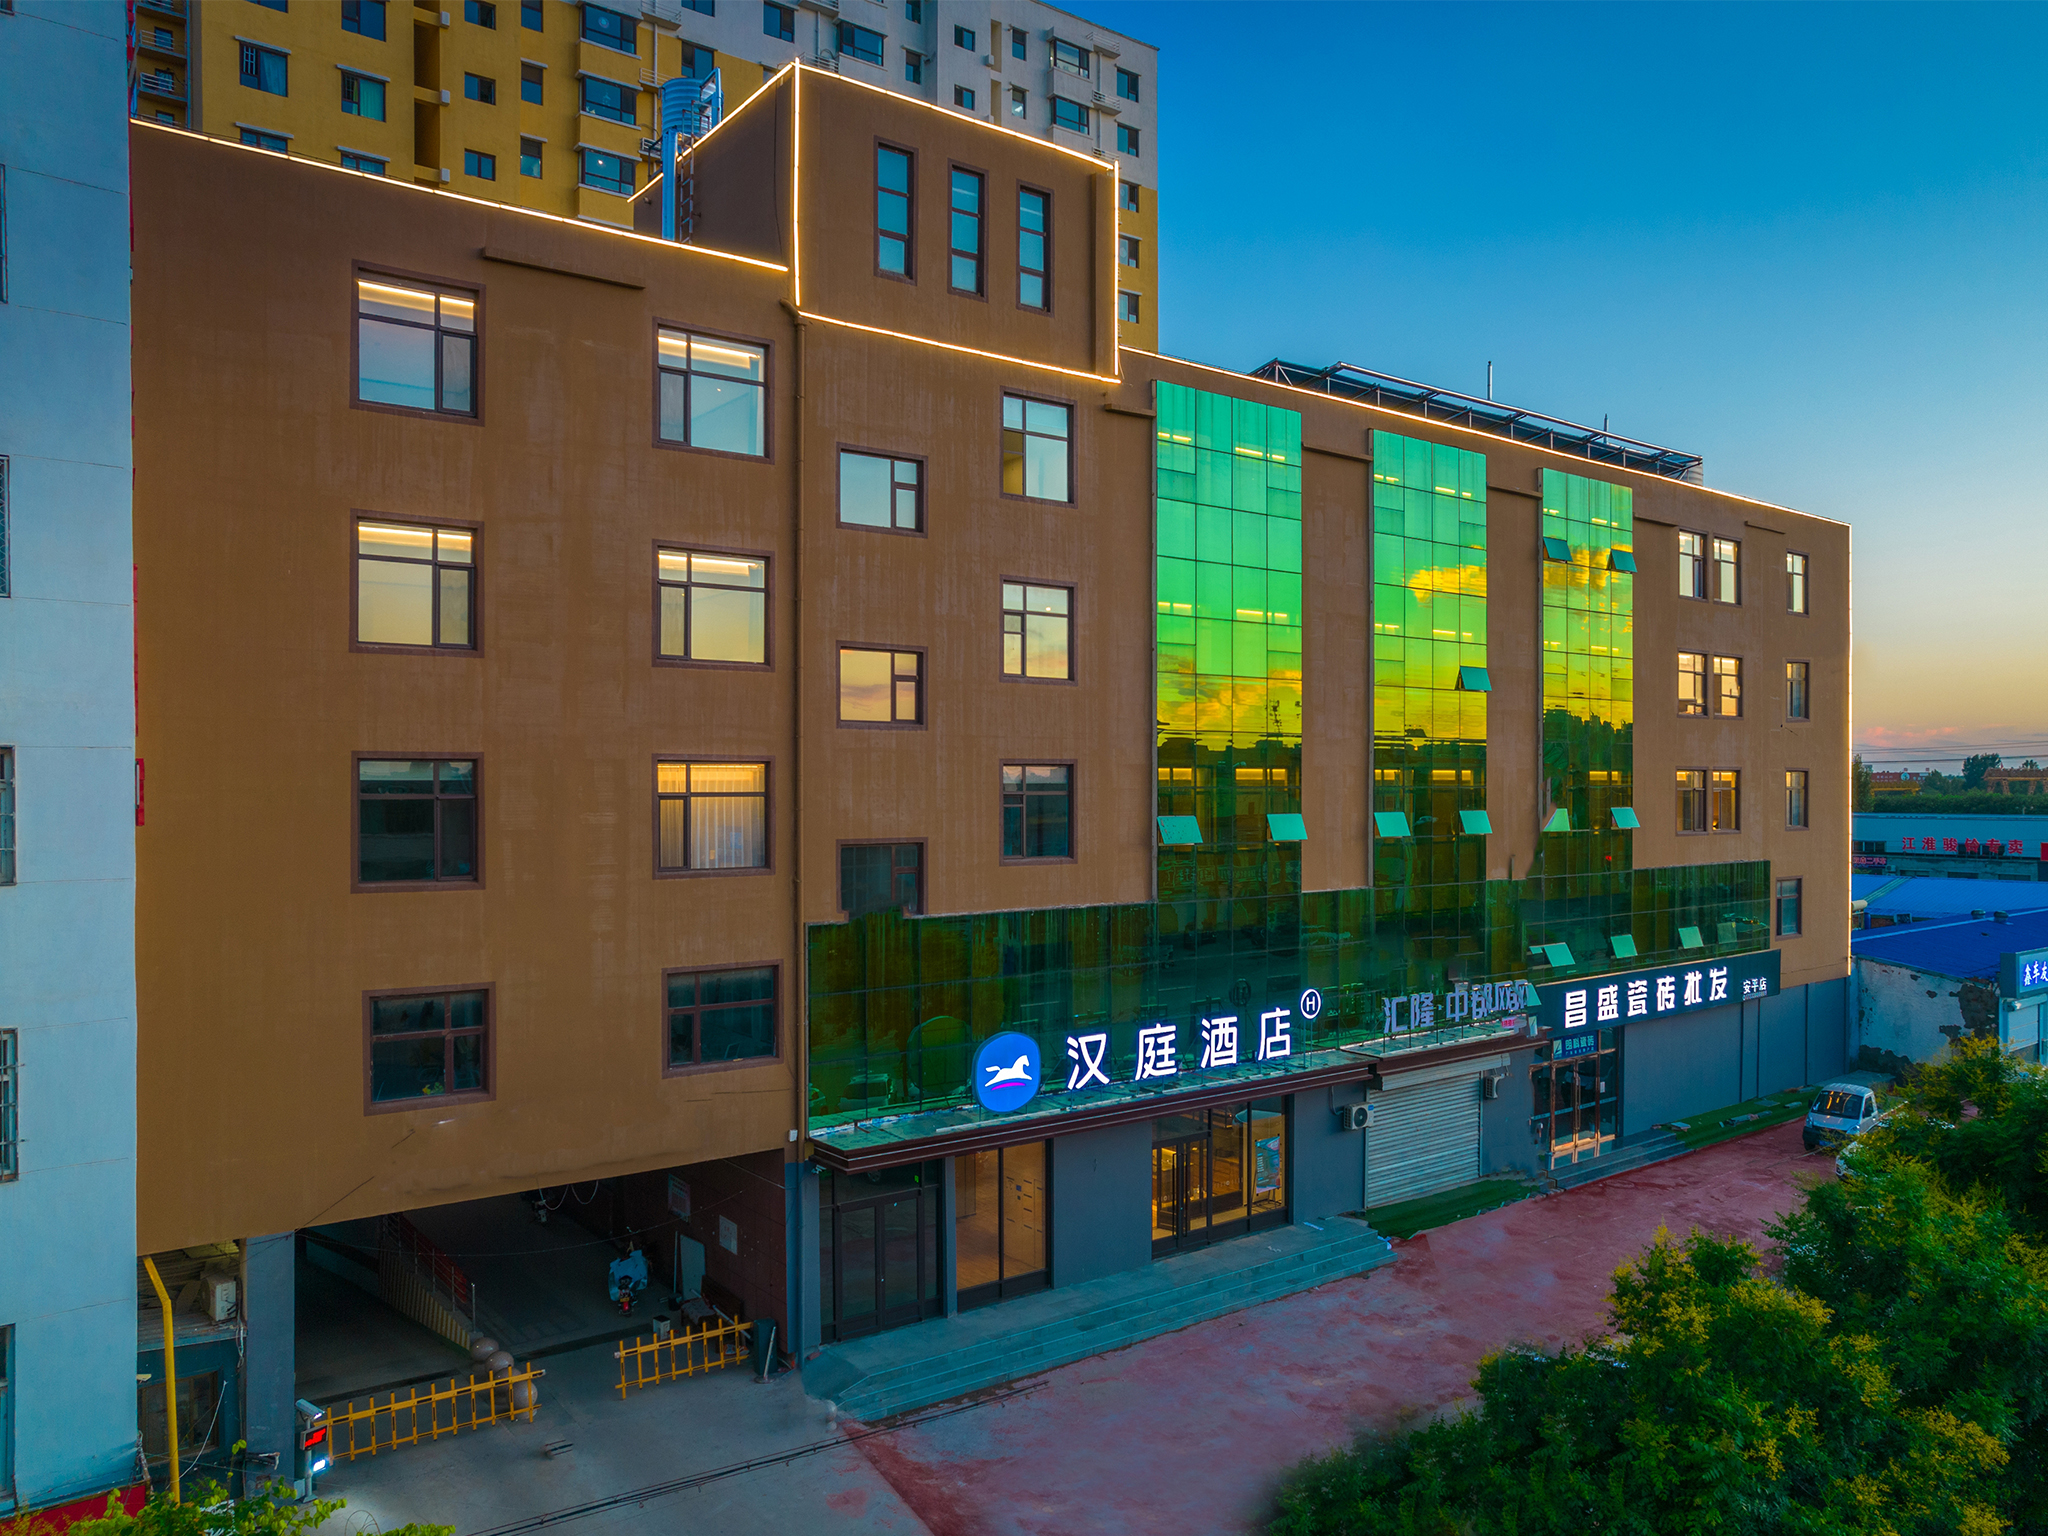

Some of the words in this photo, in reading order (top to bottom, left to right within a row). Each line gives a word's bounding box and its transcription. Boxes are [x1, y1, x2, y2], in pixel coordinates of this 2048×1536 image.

[1902, 836, 2024, 855] 江淮骏铃专卖
[1564, 966, 1728, 1029] 昌盛瓷砖批发
[1743, 976, 1767, 994] 安平店
[1065, 1006, 1293, 1090] 汉庭酒店
